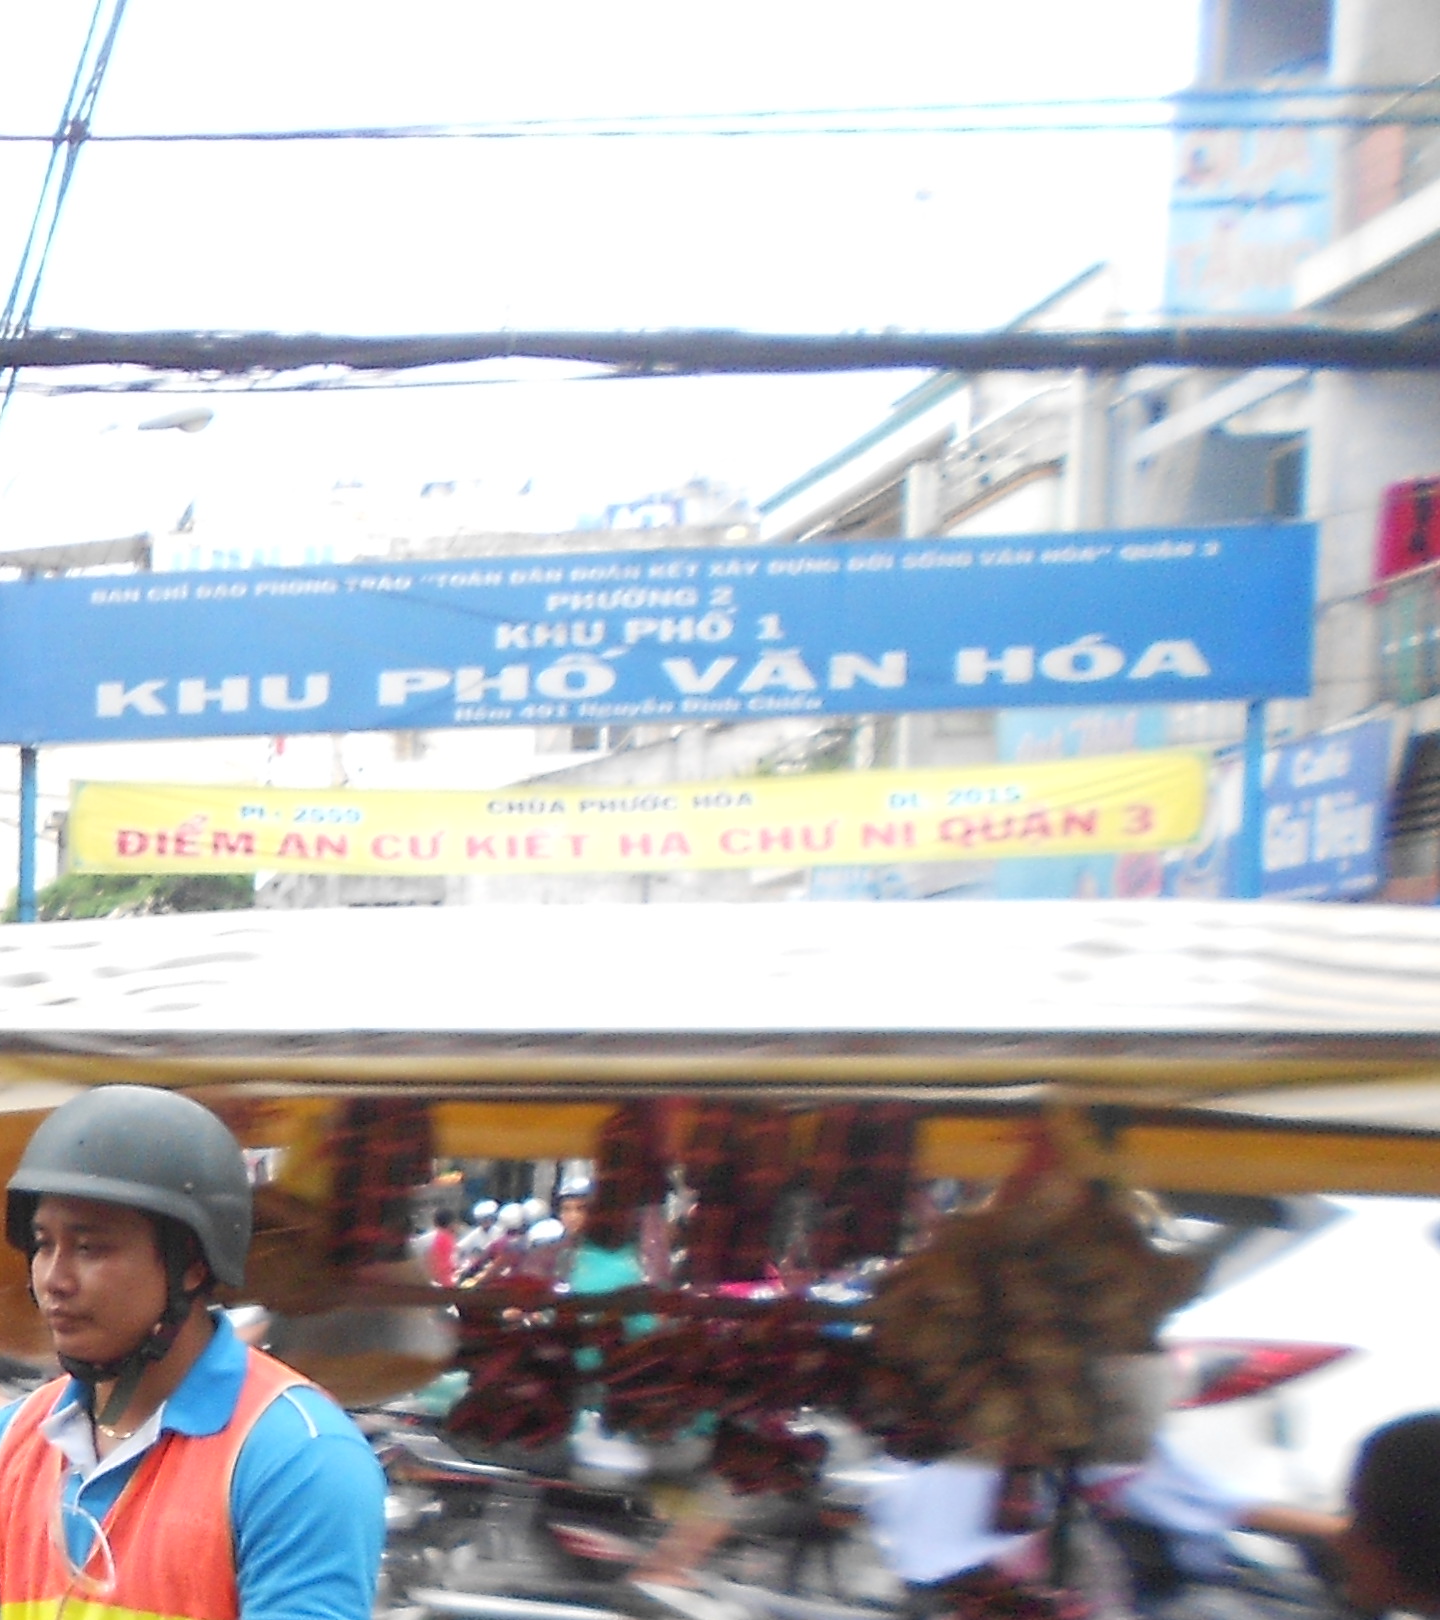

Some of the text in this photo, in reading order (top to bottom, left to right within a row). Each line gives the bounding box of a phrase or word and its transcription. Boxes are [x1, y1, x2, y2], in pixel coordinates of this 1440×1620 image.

[710, 584, 736, 607] 2
[495, 606, 786, 650] KHU PHỐ 1
[95, 632, 1212, 718] KHU PHỐ VĂN HÓA
[276, 830, 351, 860] AN
[370, 830, 447, 861] CƯ
[860, 820, 917, 849] NI
[1122, 803, 1156, 836] 3
